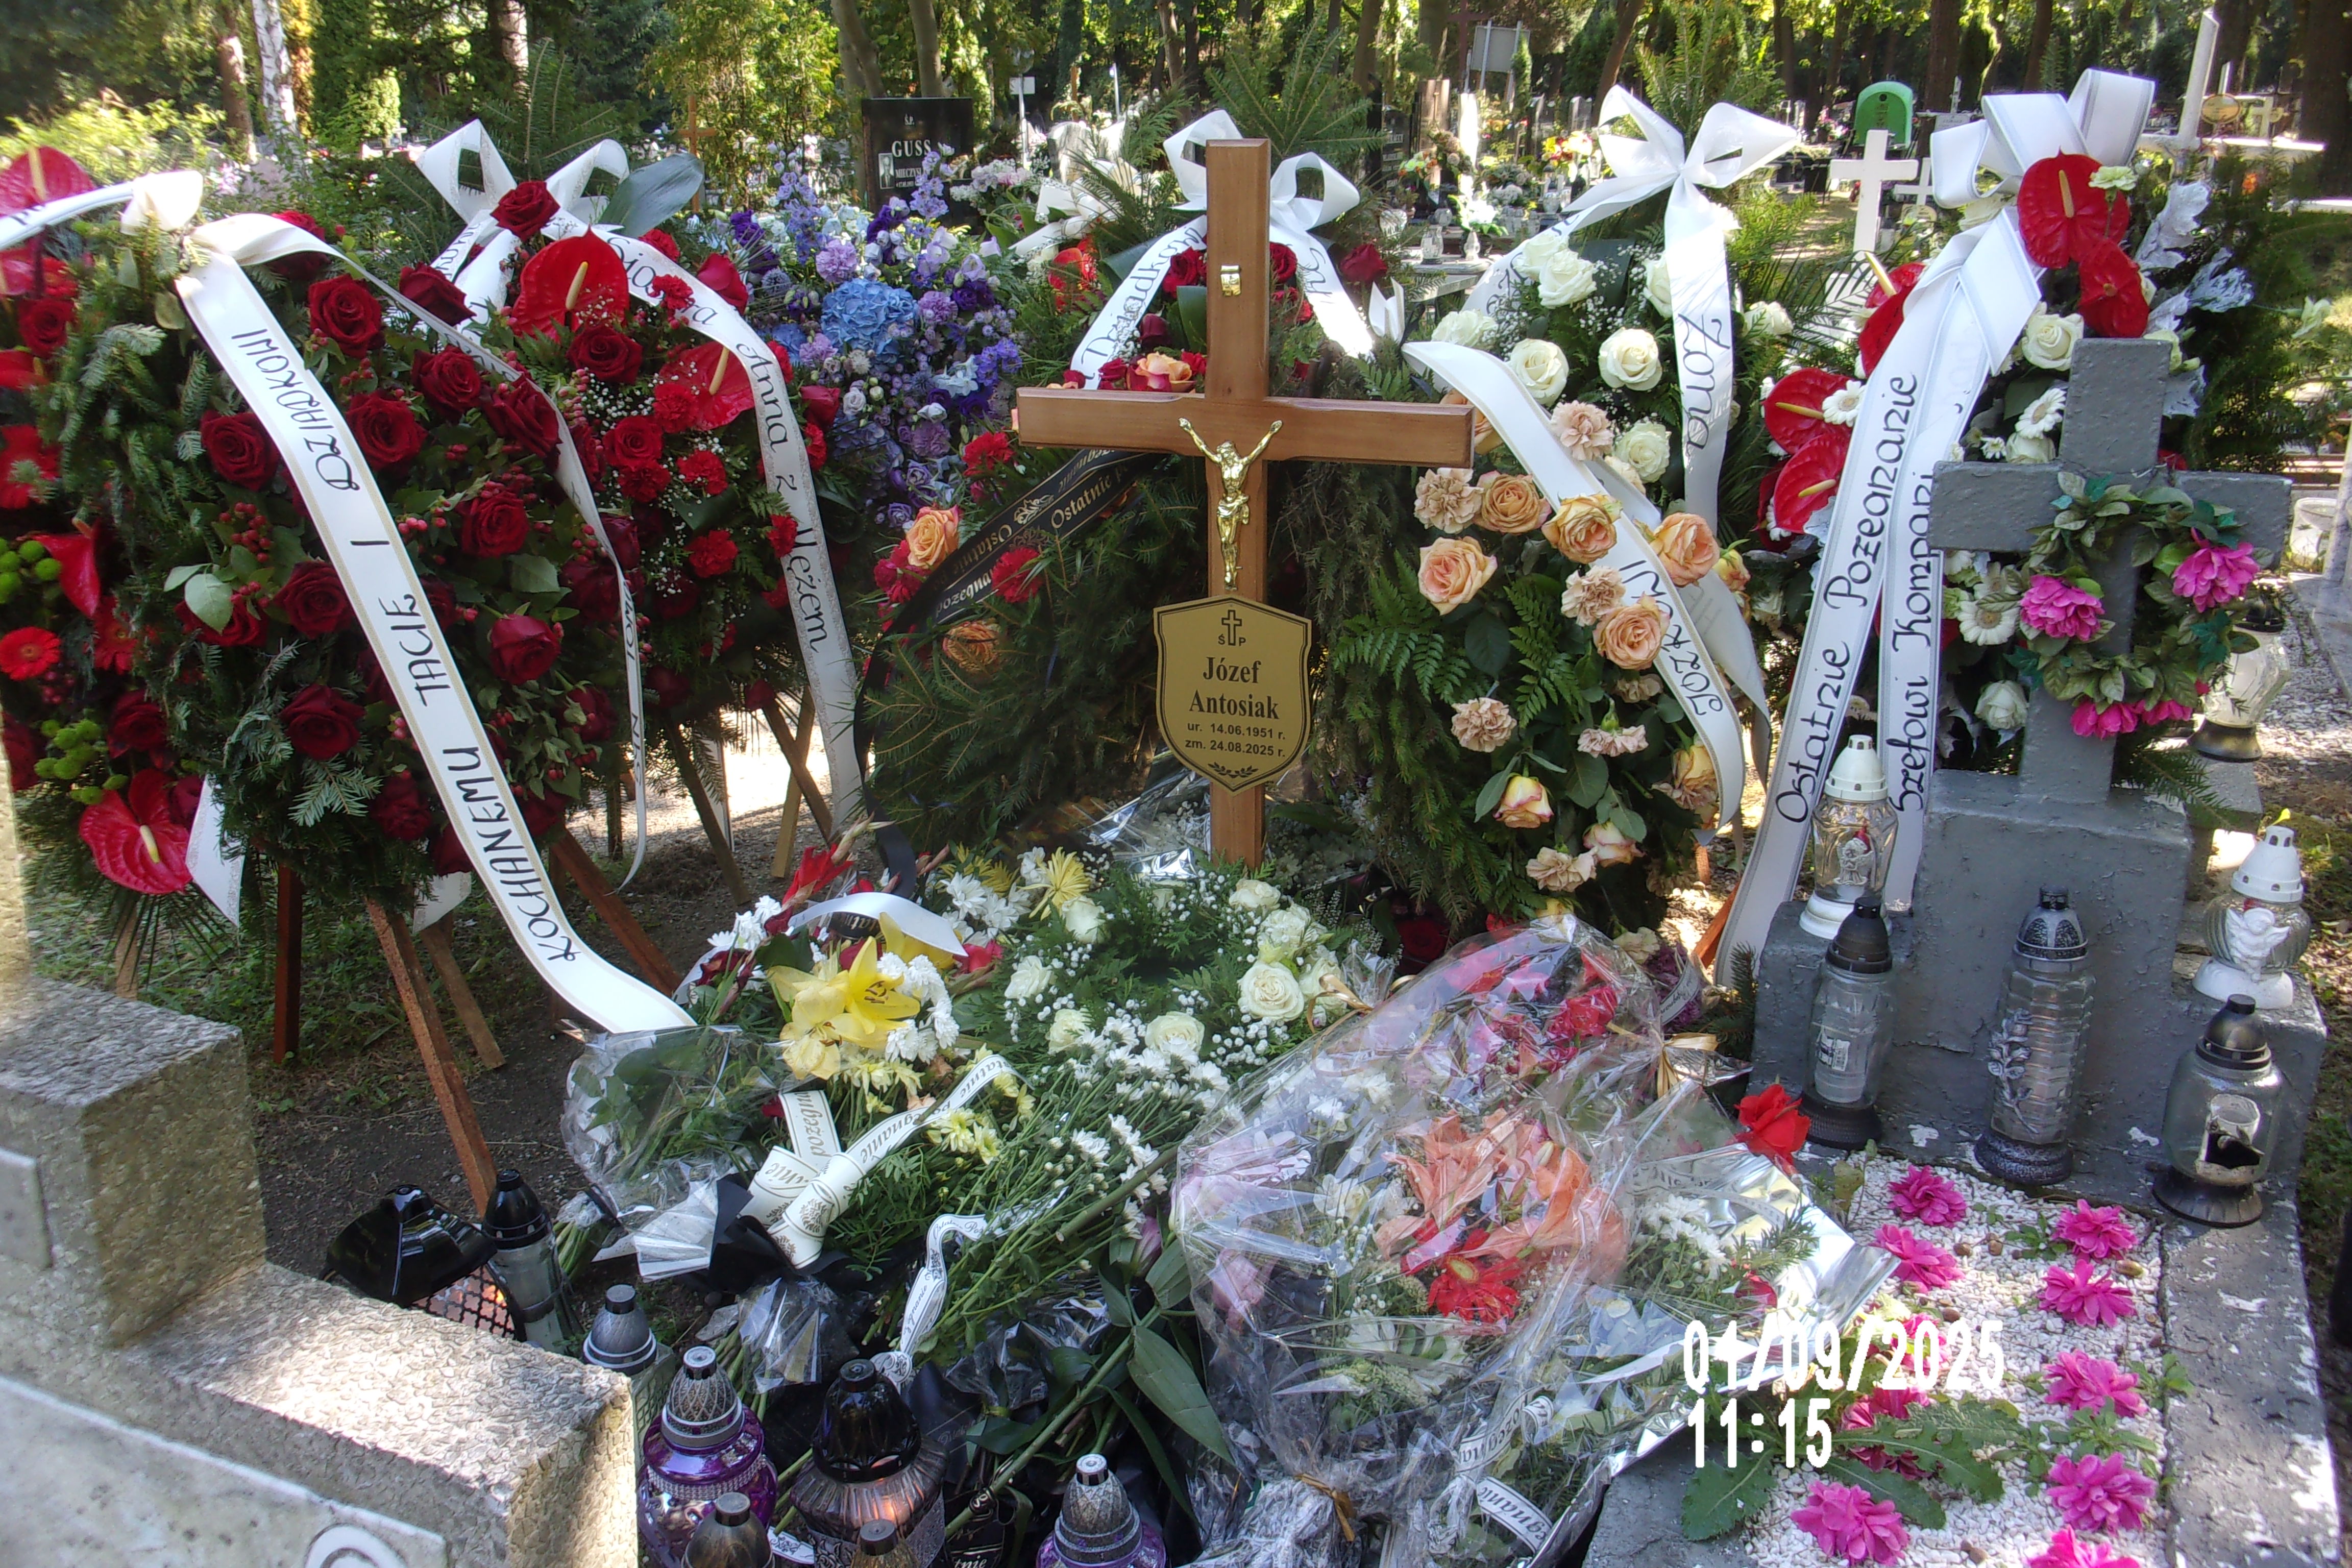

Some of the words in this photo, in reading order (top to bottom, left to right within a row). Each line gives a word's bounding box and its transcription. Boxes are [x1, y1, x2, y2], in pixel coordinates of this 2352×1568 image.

[892, 139, 932, 157] GUSS
[231, 332, 359, 492] DZIADKOWI
[735, 341, 789, 454] Anna
[774, 474, 797, 494] z
[1050, 474, 1113, 530] Ostatnie
[378, 593, 451, 707] TACIE
[1218, 633, 1226, 646] Ś
[1238, 637, 1246, 647] P
[1203, 656, 1262, 684] Józef
[1189, 689, 1280, 720] Antosiak
[1185, 740, 1206, 750] zm.
[1210, 740, 1275, 756] 24.08.2025
[1278, 749, 1286, 757] r.
[1187, 722, 1203, 732] ur.
[1210, 723, 1273, 739] 14.06.1951
[1278, 731, 1286, 740] r.
[1775, 640, 1851, 823] Ostatnie
[442, 746, 578, 964] KOCHANEMU
